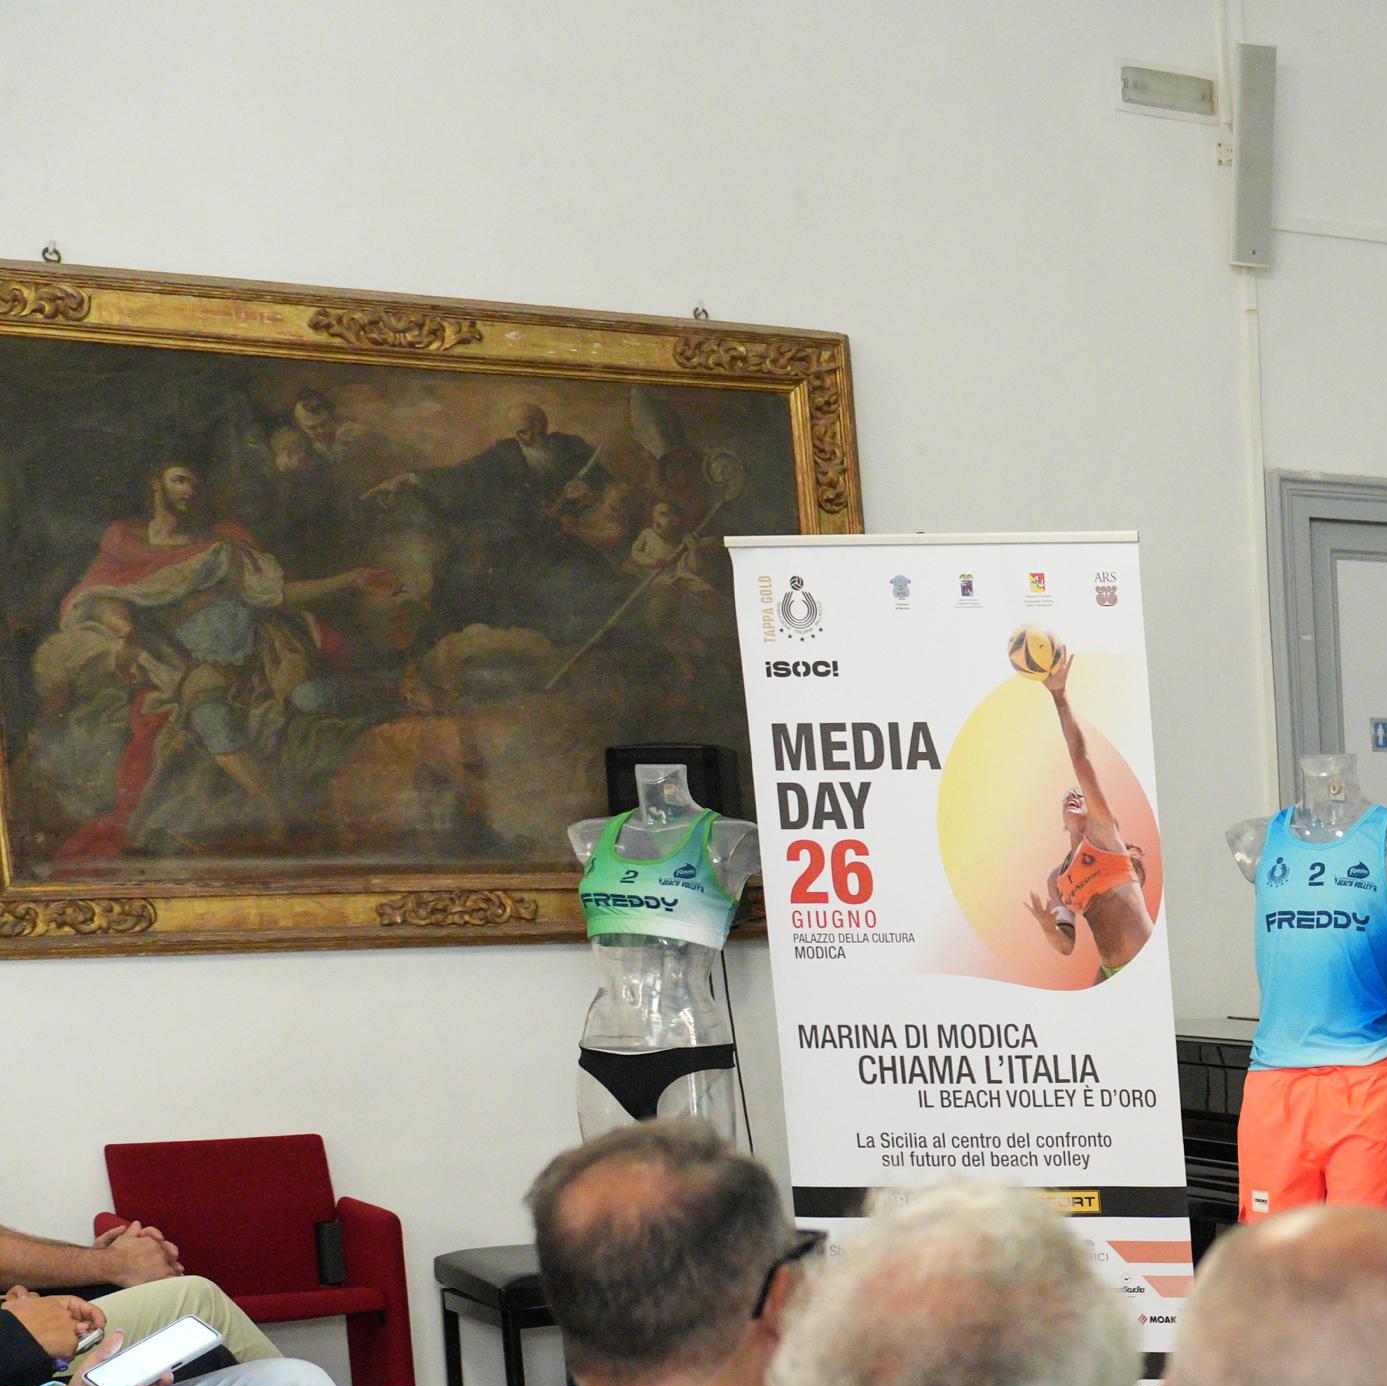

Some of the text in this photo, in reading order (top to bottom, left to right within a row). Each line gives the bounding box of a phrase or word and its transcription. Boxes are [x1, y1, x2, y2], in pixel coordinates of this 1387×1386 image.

[1095, 572, 1116, 582] ARS
[758, 575, 777, 644] TAPPA GOLD
[772, 722, 941, 771] MEDIA
[777, 782, 871, 830] DAY
[620, 870, 639, 884] 2
[787, 839, 873, 904] 26
[1308, 862, 1326, 887] 2
[581, 892, 678, 912] FREDDY
[792, 910, 876, 928] GIUGNO
[1265, 910, 1370, 933] FREDDY
[793, 933, 915, 943] PALAZZO DELLA CULTURA
[795, 946, 846, 959] MODICA
[798, 1024, 1038, 1049] MARINA DI MODICA
[859, 1055, 1100, 1085] CHIAMA L'ITALIA
[919, 1085, 1156, 1108] IL BEACH VOLLEY È D'ORO
[857, 1132, 1112, 1148] La Sicilia al centro del confronto
[882, 1151, 1090, 1169] sul futuro del beach volley
